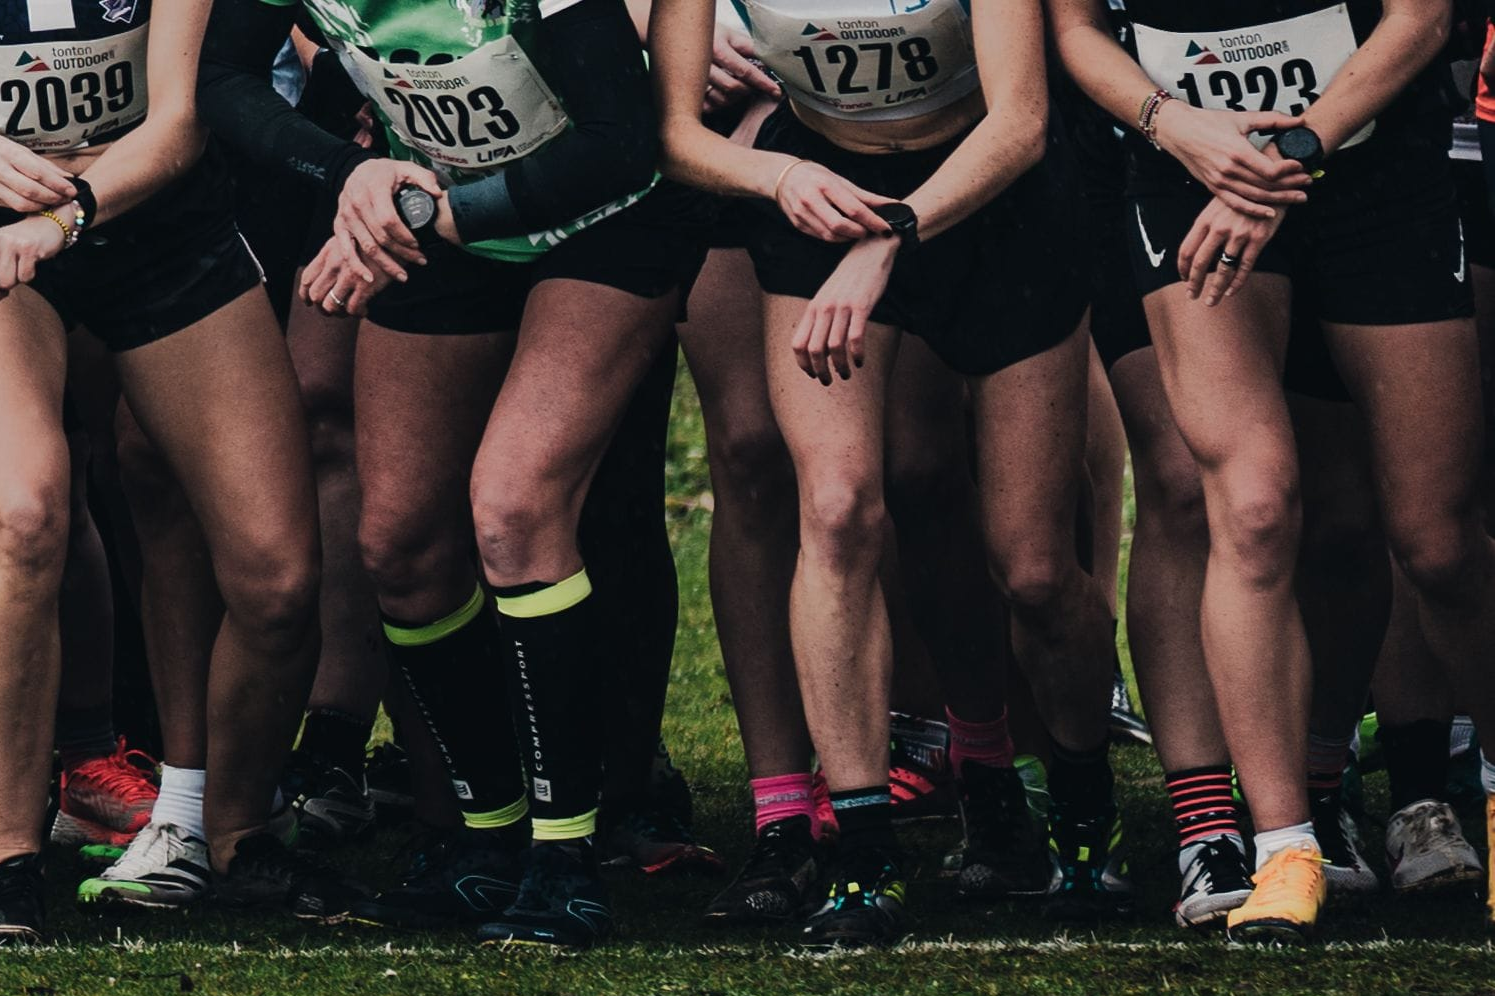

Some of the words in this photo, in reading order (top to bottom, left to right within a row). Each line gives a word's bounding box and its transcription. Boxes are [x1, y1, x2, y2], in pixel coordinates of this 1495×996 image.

[837, 20, 879, 29] tonton
[840, 28, 899, 40] OUTDOOR
[1219, 33, 1262, 48] tonton
[52, 47, 92, 57] tonton
[1223, 43, 1282, 63] OUTDOOR
[53, 53, 109, 70] OUTDOOR
[793, 37, 939, 95] 1278
[406, 69, 442, 79] tonton
[413, 77, 464, 89] OUTDOOR
[1, 61, 134, 137] 2039
[885, 87, 927, 104] LIFA
[384, 86, 520, 148] 2023
[81, 118, 119, 139] LIFA
[477, 145, 516, 162] LIFA
[515, 640, 544, 772] COMPRESSPORT
